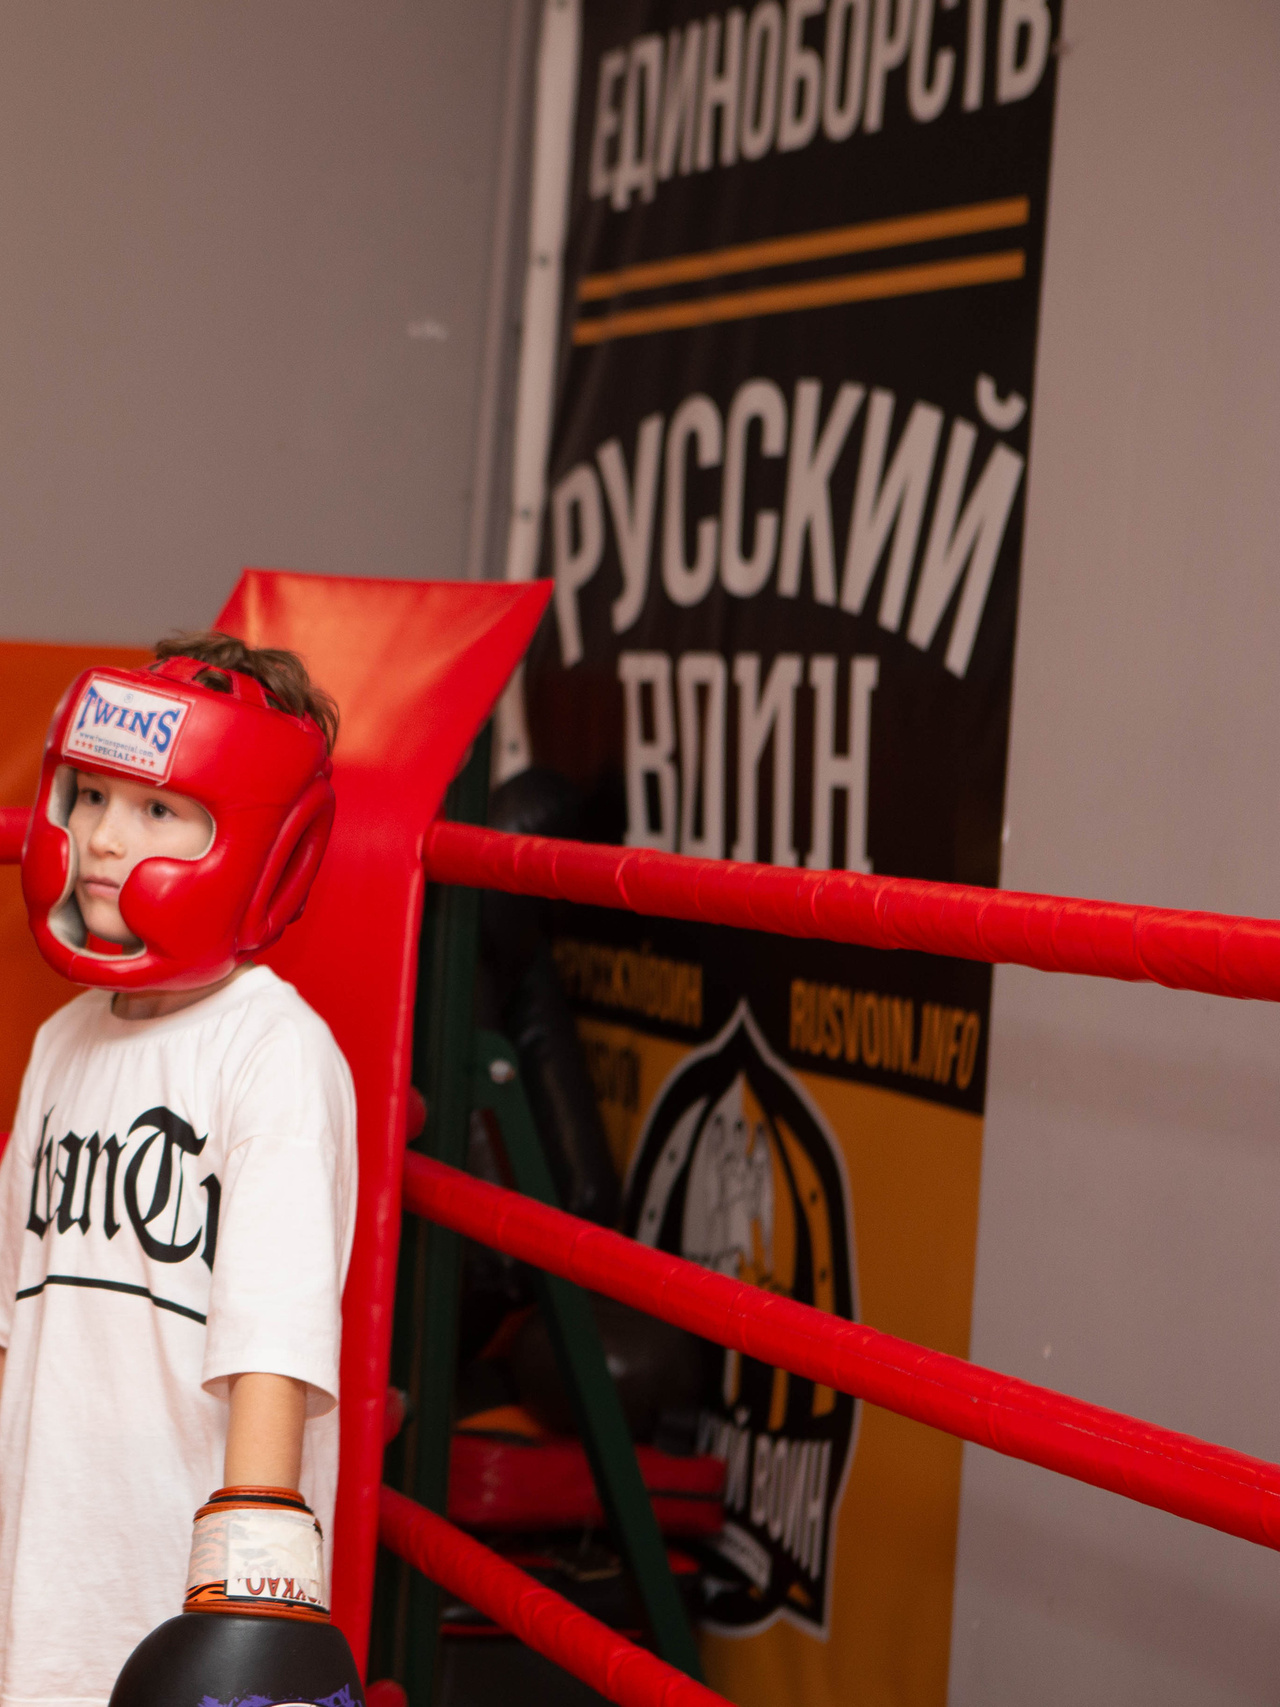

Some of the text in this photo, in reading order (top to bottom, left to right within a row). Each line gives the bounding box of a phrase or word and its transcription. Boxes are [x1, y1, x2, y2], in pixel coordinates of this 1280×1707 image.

[551, 372, 1027, 680] РУССКИЙ
[76, 685, 181, 754] TWINS
[93, 744, 131, 762] SPECIAL
[618, 650, 880, 876] ВОИН
[789, 977, 982, 1091] RUSVOIN.INFO
